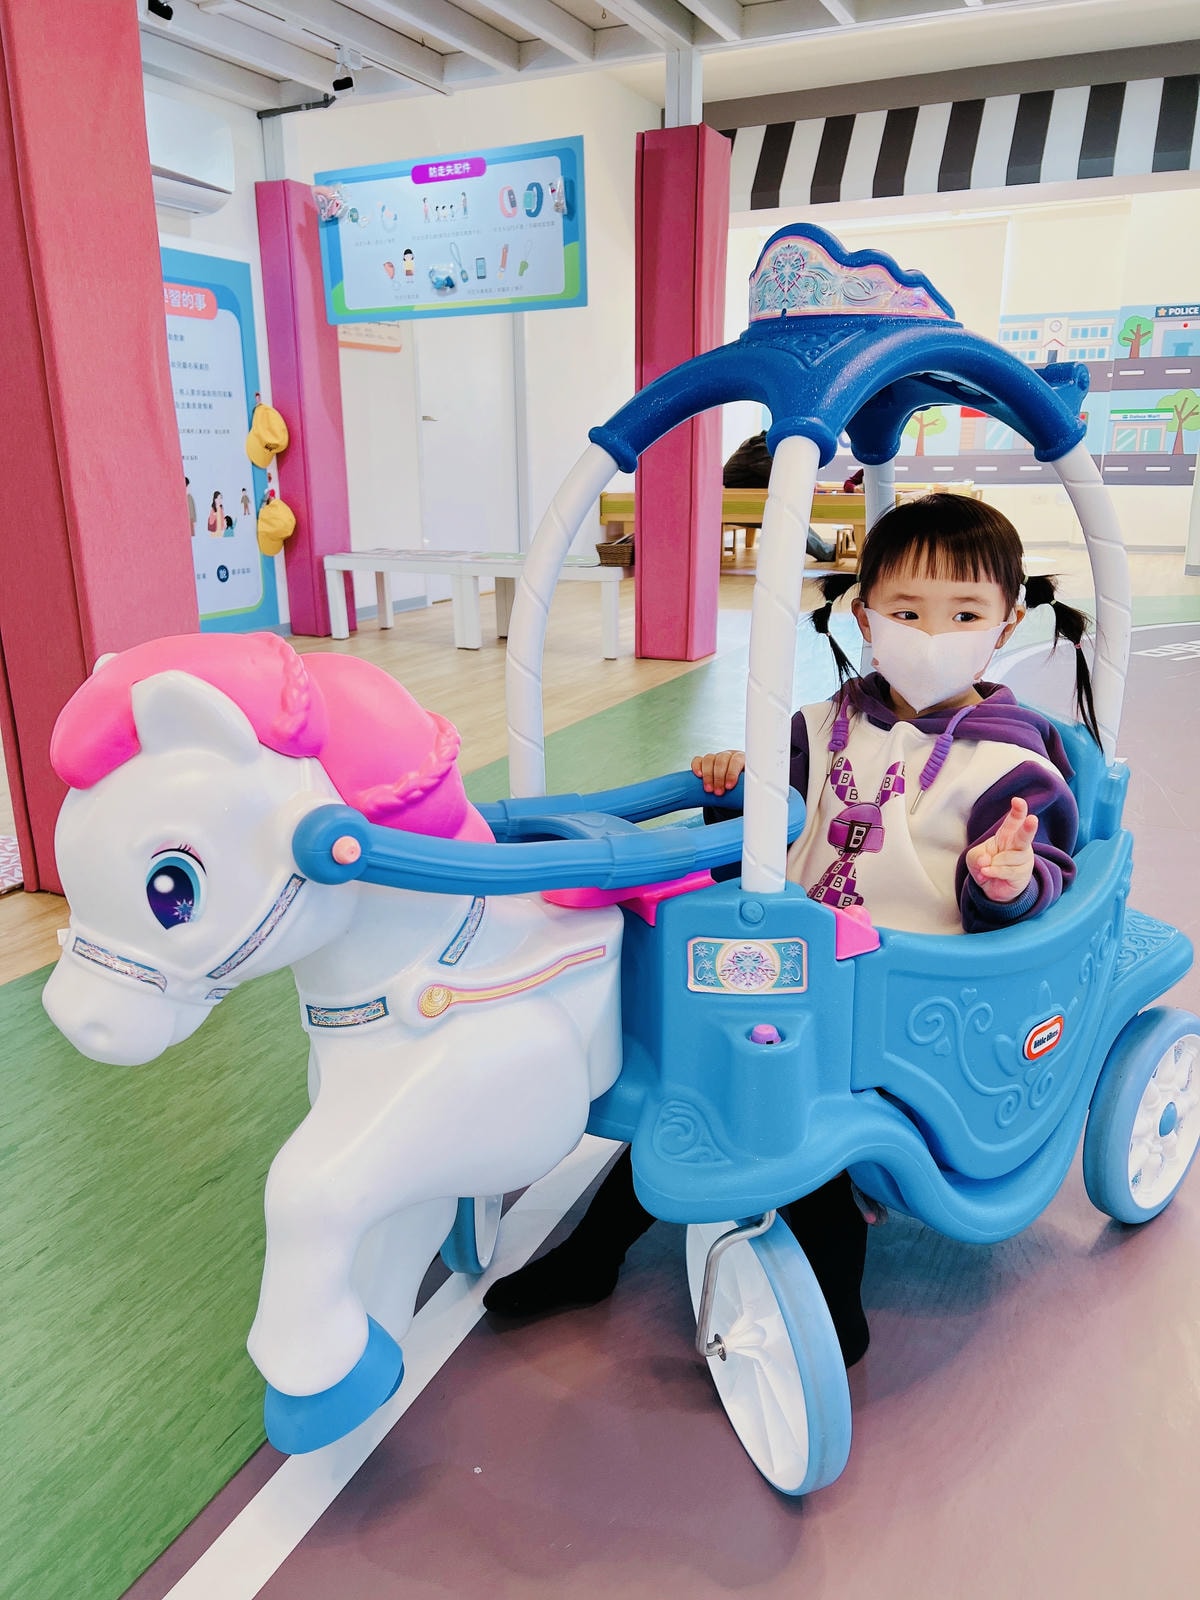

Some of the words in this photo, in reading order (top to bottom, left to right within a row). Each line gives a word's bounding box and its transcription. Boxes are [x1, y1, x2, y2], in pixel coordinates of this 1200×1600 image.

[428, 162, 472, 179] 防走失配件
[1168, 306, 1200, 316] POLICE
[835, 757, 845, 768] B
[841, 773, 850, 784] B
[884, 777, 891, 789] B
[849, 789, 859, 801] B
[849, 826, 867, 848] B
[833, 863, 842, 873] B
[833, 876, 843, 888] B
[815, 888, 824, 898] B
[842, 896, 853, 907] B
